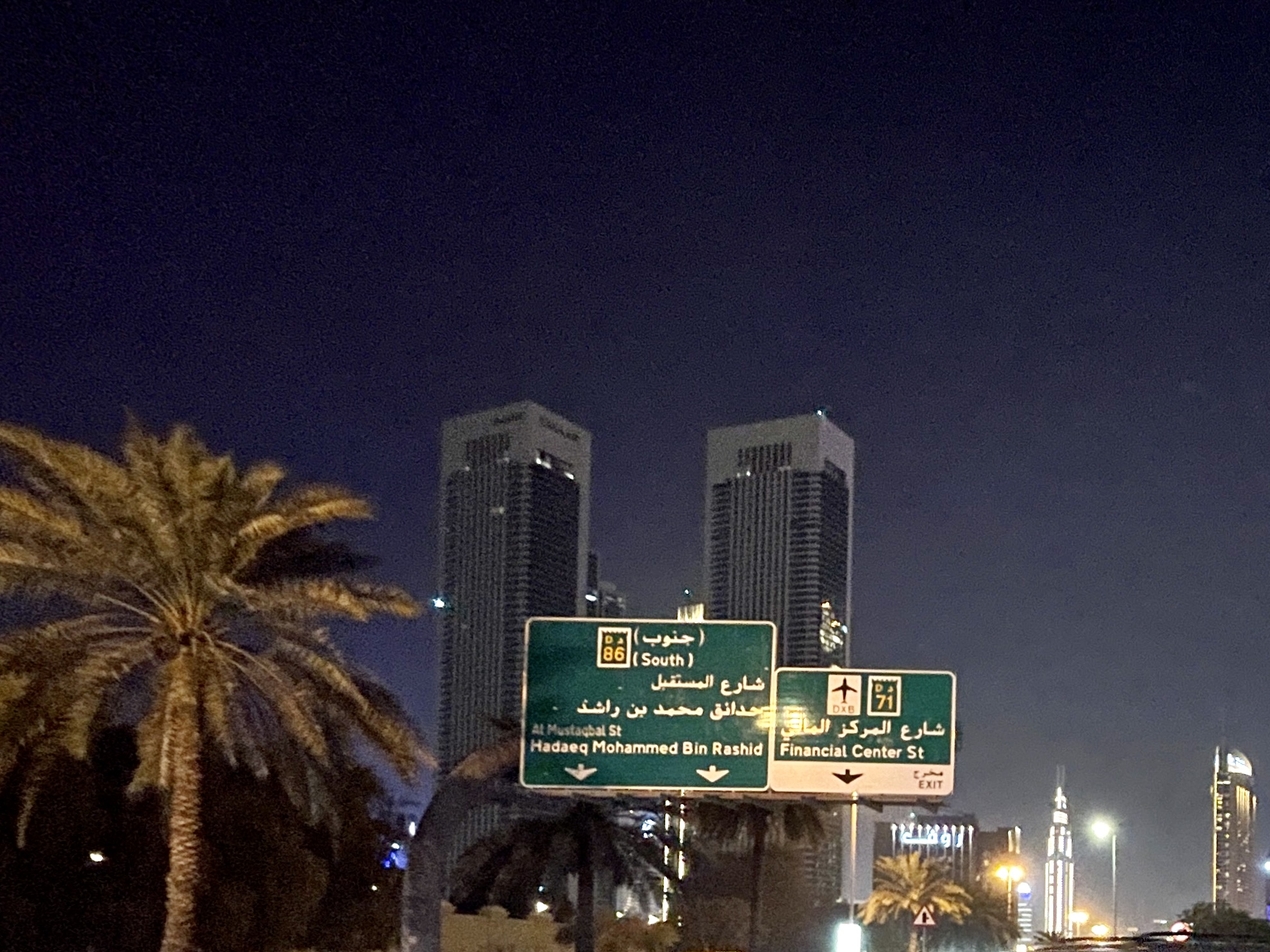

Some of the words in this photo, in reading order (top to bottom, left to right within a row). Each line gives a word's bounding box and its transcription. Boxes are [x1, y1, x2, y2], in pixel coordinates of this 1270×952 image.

[603, 646, 625, 661] 86
[651, 674, 714, 691] المستقبل
[720, 675, 765, 696] شارع
[577, 699, 620, 718] راشد
[653, 703, 704, 716] محمد
[832, 704, 855, 714] DXB
[876, 694, 894, 710] 71
[626, 703, 648, 719] بن
[609, 724, 622, 737] St
[900, 721, 945, 740] شارع
[530, 740, 588, 756] Hadaeq
[592, 740, 678, 754] Mohammed
[682, 741, 708, 755] Bin
[712, 742, 763, 756] Rashid
[780, 743, 847, 758] Financial
[852, 744, 902, 759] Center
[907, 746, 924, 760] St
[918, 780, 944, 790] EXIT
